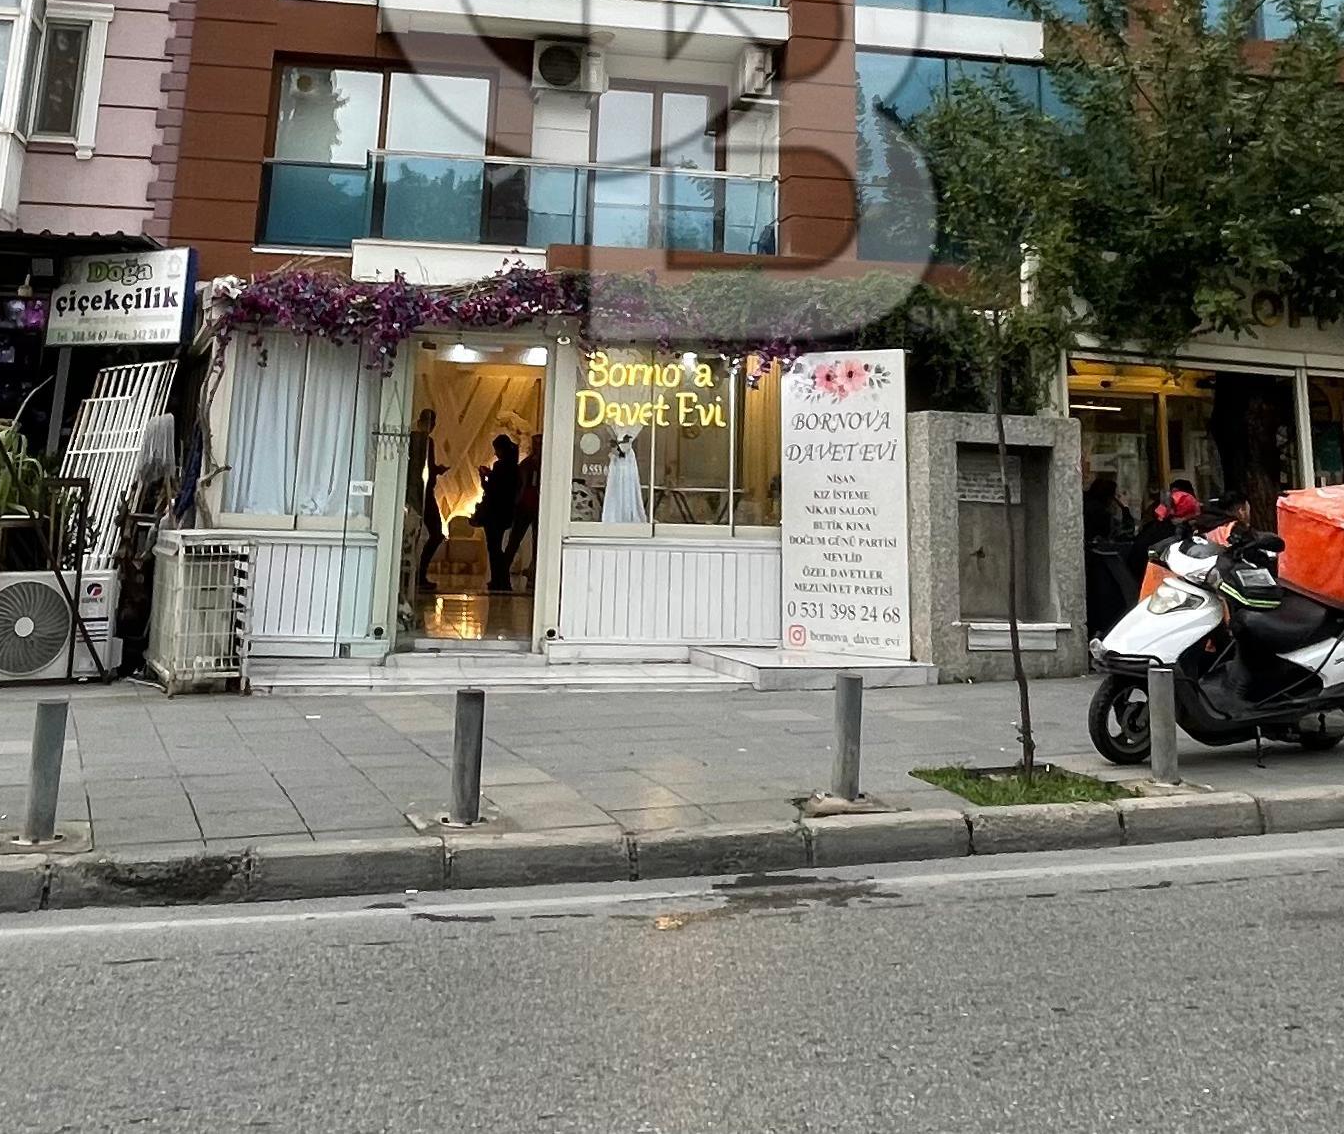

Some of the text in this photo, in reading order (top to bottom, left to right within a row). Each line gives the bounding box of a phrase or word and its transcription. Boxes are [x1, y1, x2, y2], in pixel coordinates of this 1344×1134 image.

[86, 257, 154, 286] Doğa
[56, 287, 179, 317] çiçekçilik
[588, 351, 715, 388] Bornoa
[576, 389, 727, 428] Davet Evi
[792, 410, 892, 434] BORNOVA
[785, 439, 898, 465] DAVET EVİ
[813, 489, 871, 500] KIZ İSTEME
[838, 506, 878, 516] SALONU
[846, 521, 871, 532] KINA
[789, 534, 826, 545] DOĞUM
[830, 568, 883, 580] DAVETLER
[787, 601, 901, 624] 0 531 398 24 68
